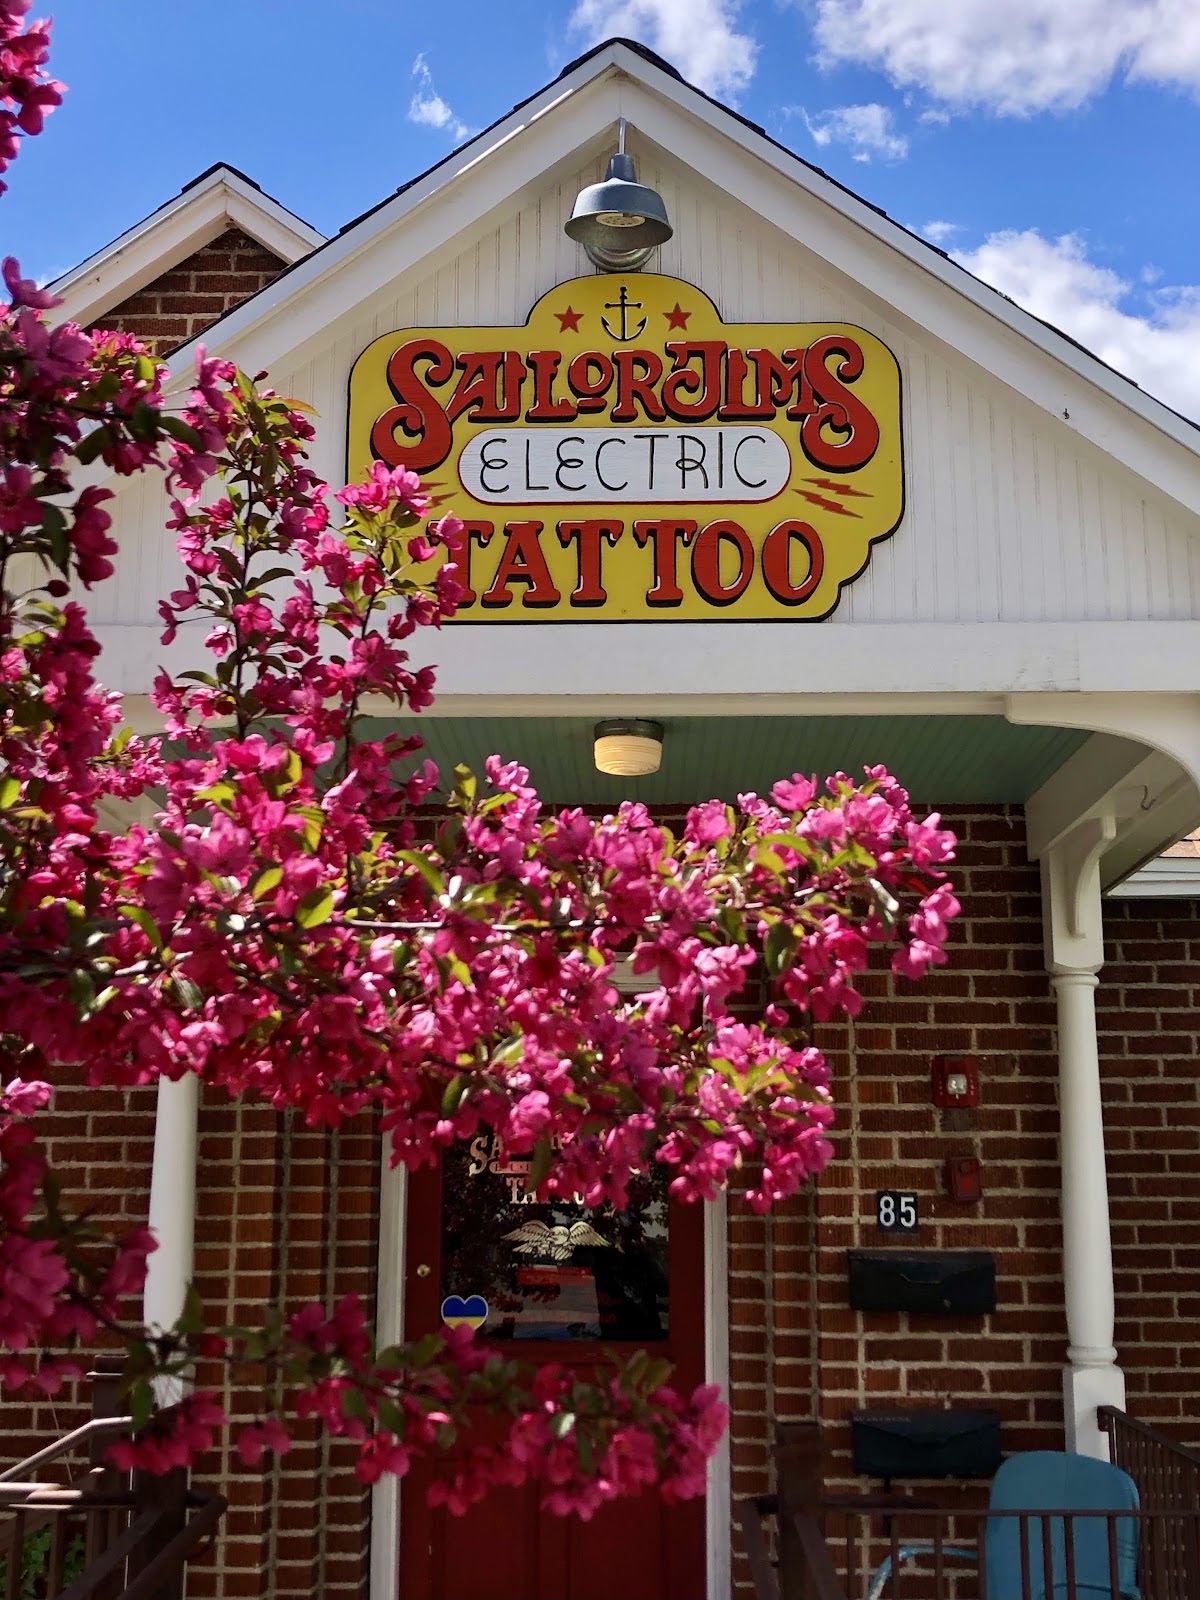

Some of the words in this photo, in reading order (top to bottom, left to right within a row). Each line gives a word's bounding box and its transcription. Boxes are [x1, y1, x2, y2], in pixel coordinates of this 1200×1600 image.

[371, 338, 665, 472] SAILOR
[479, 430, 768, 493] ELECTRIC
[426, 517, 825, 609] TATTOO
[879, 1195, 916, 1228] 85
